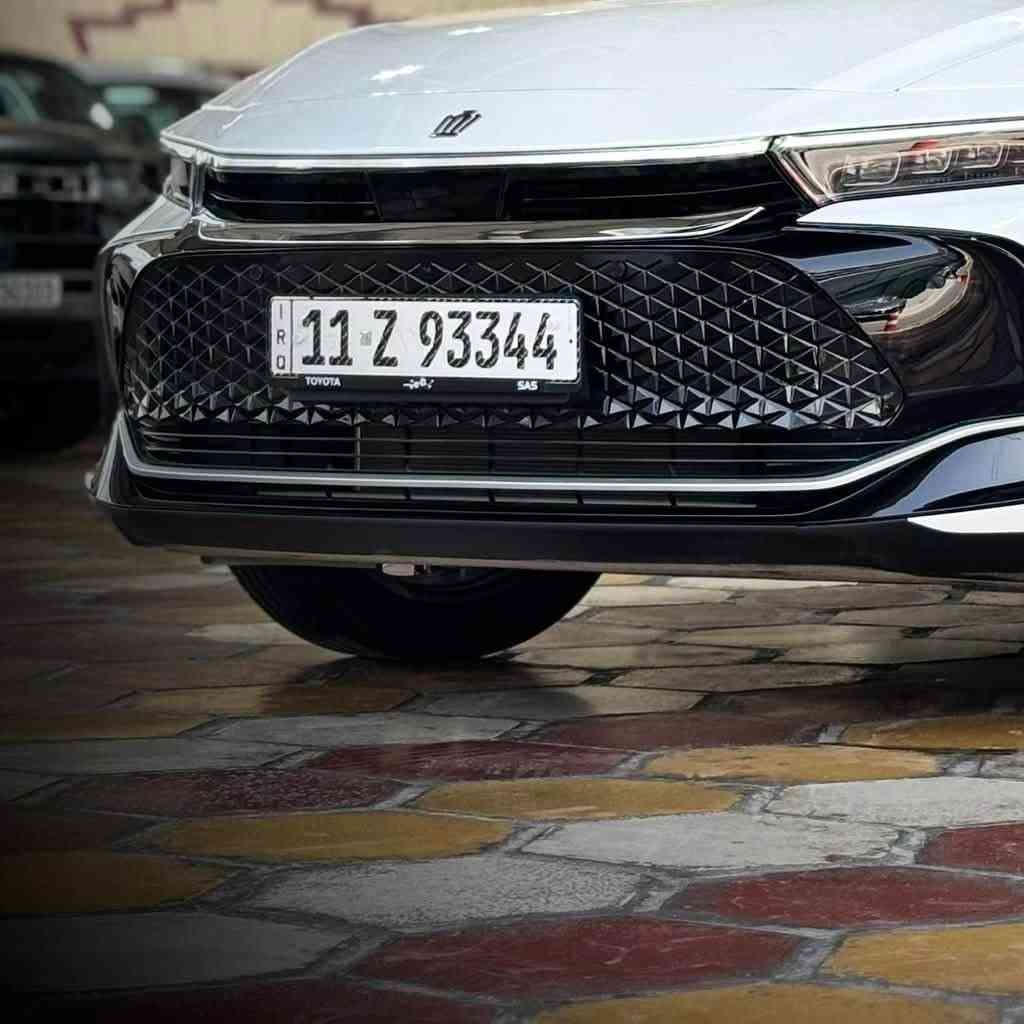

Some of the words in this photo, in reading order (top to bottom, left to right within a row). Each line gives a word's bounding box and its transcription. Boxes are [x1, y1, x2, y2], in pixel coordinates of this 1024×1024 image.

[301, 309, 354, 366] 11
[372, 309, 399, 367] Z
[418, 310, 558, 370] 93344
[304, 375, 342, 387] TOYOTA
[516, 380, 539, 391] SAS
